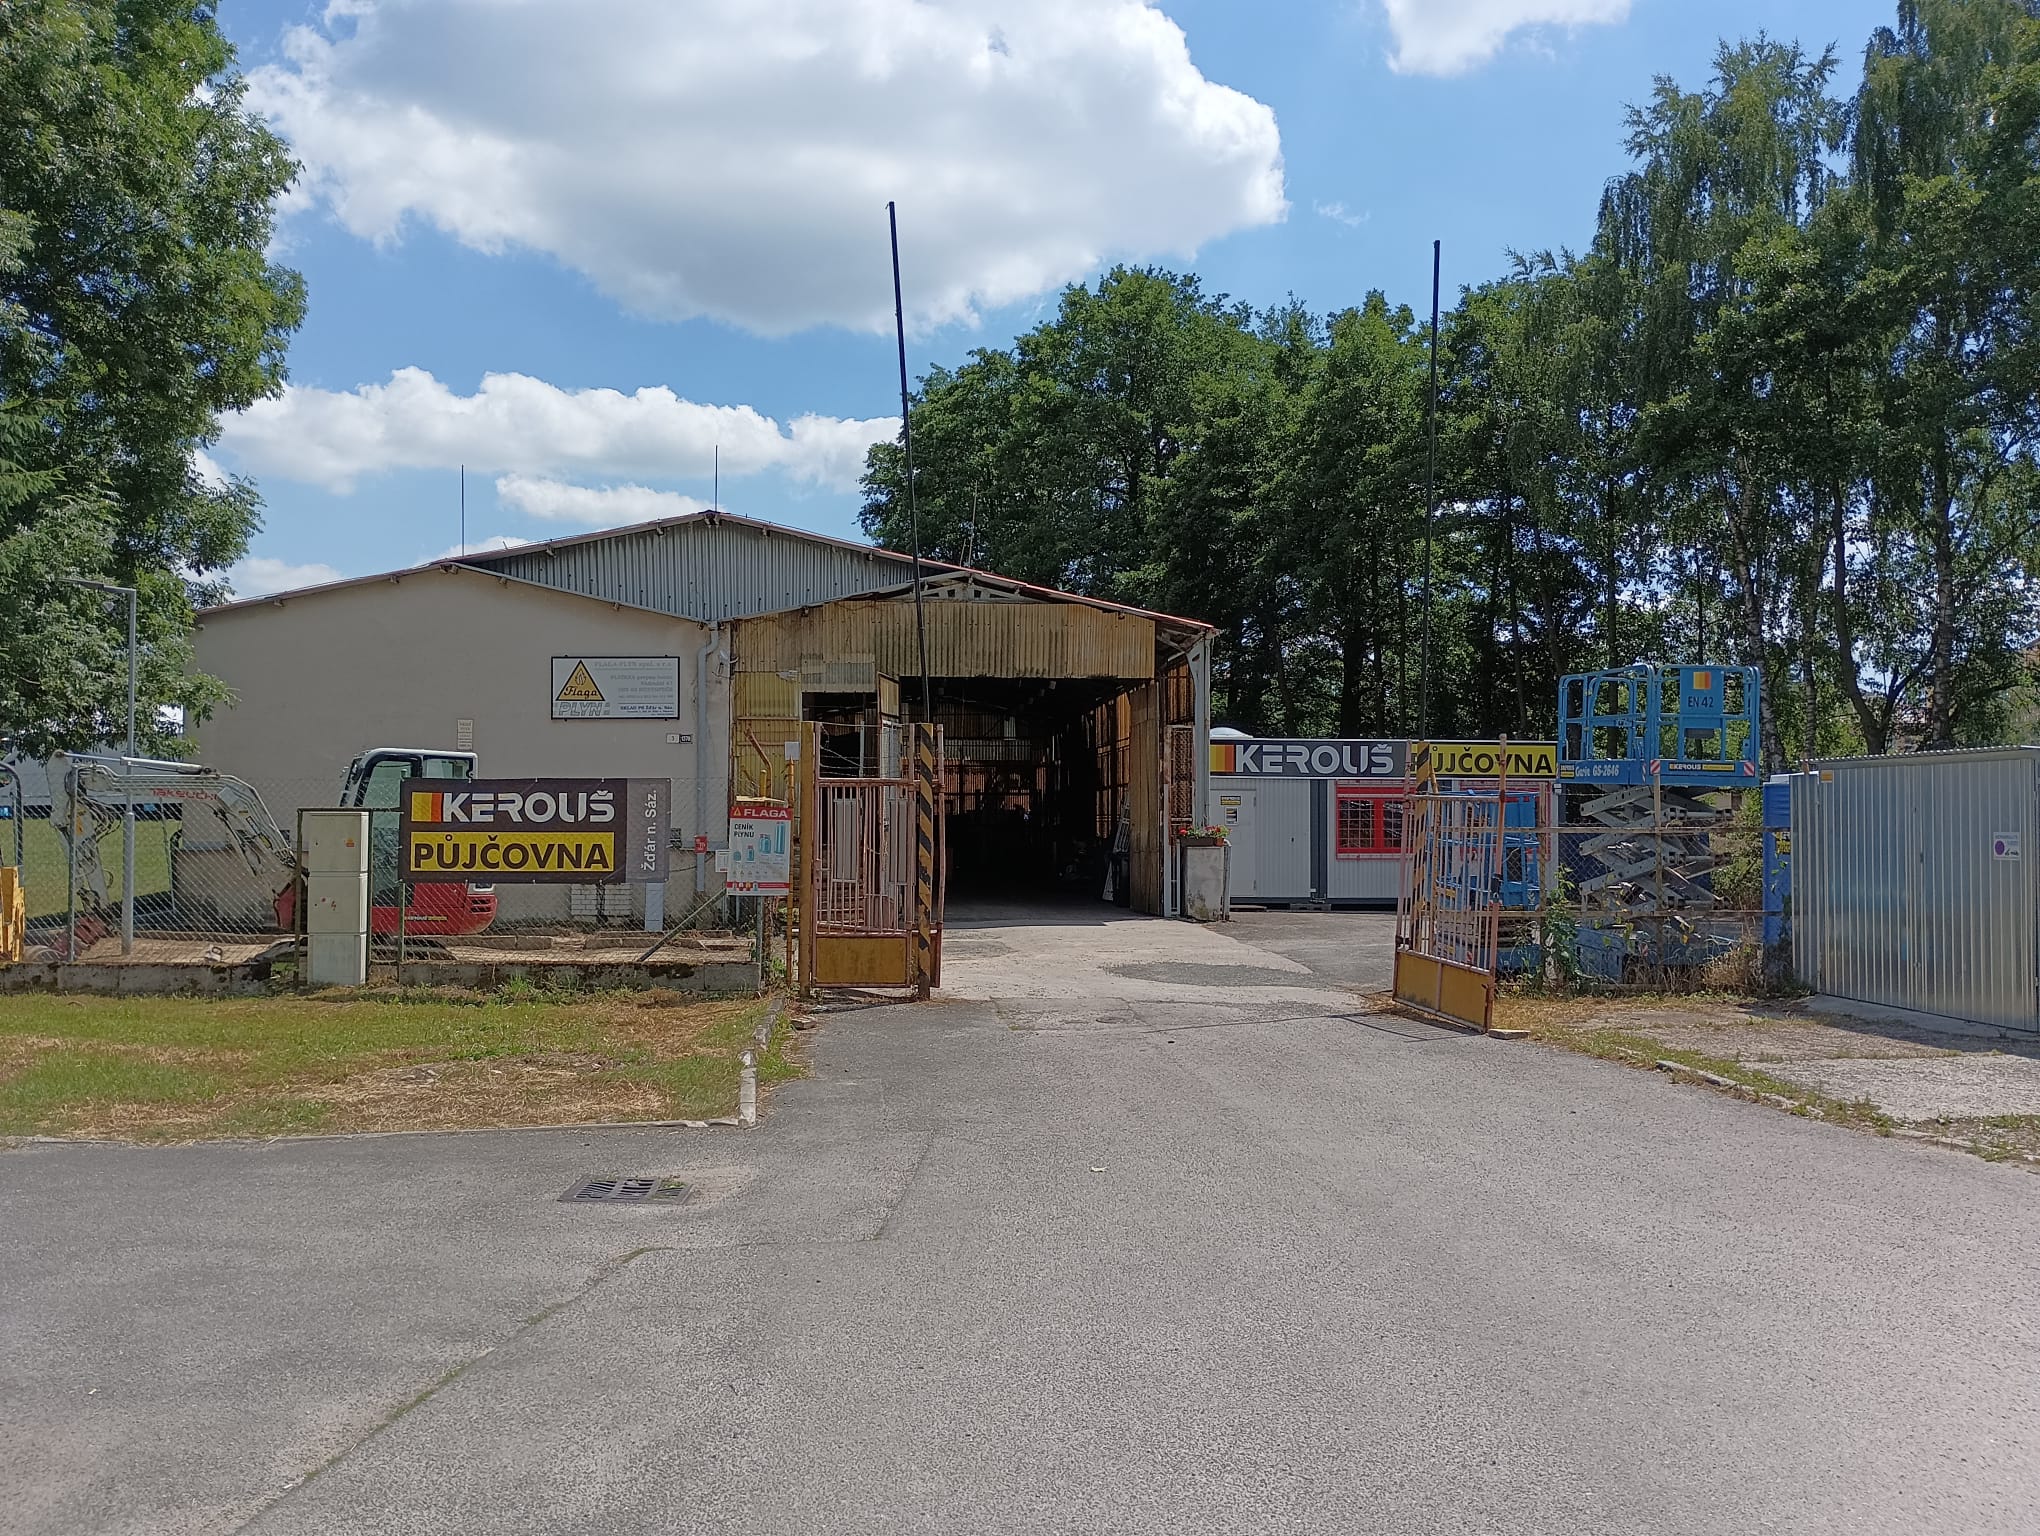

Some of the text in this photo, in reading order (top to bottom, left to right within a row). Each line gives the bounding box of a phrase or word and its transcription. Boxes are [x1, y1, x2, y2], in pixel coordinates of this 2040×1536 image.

[564, 686, 598, 700] Flaga
[558, 702, 603, 716] PLYN
[1688, 696, 1714, 708] EN 42
[1235, 744, 1394, 774] KEROUŠ
[443, 790, 615, 823] KEROUŠ
[743, 808, 788, 818] FLAGA
[640, 790, 657, 871] Žďár n. Sáz.
[734, 822, 754, 830] CENÍK
[734, 830, 755, 838] PLYNU
[414, 834, 610, 869] PŮJČOVNA
